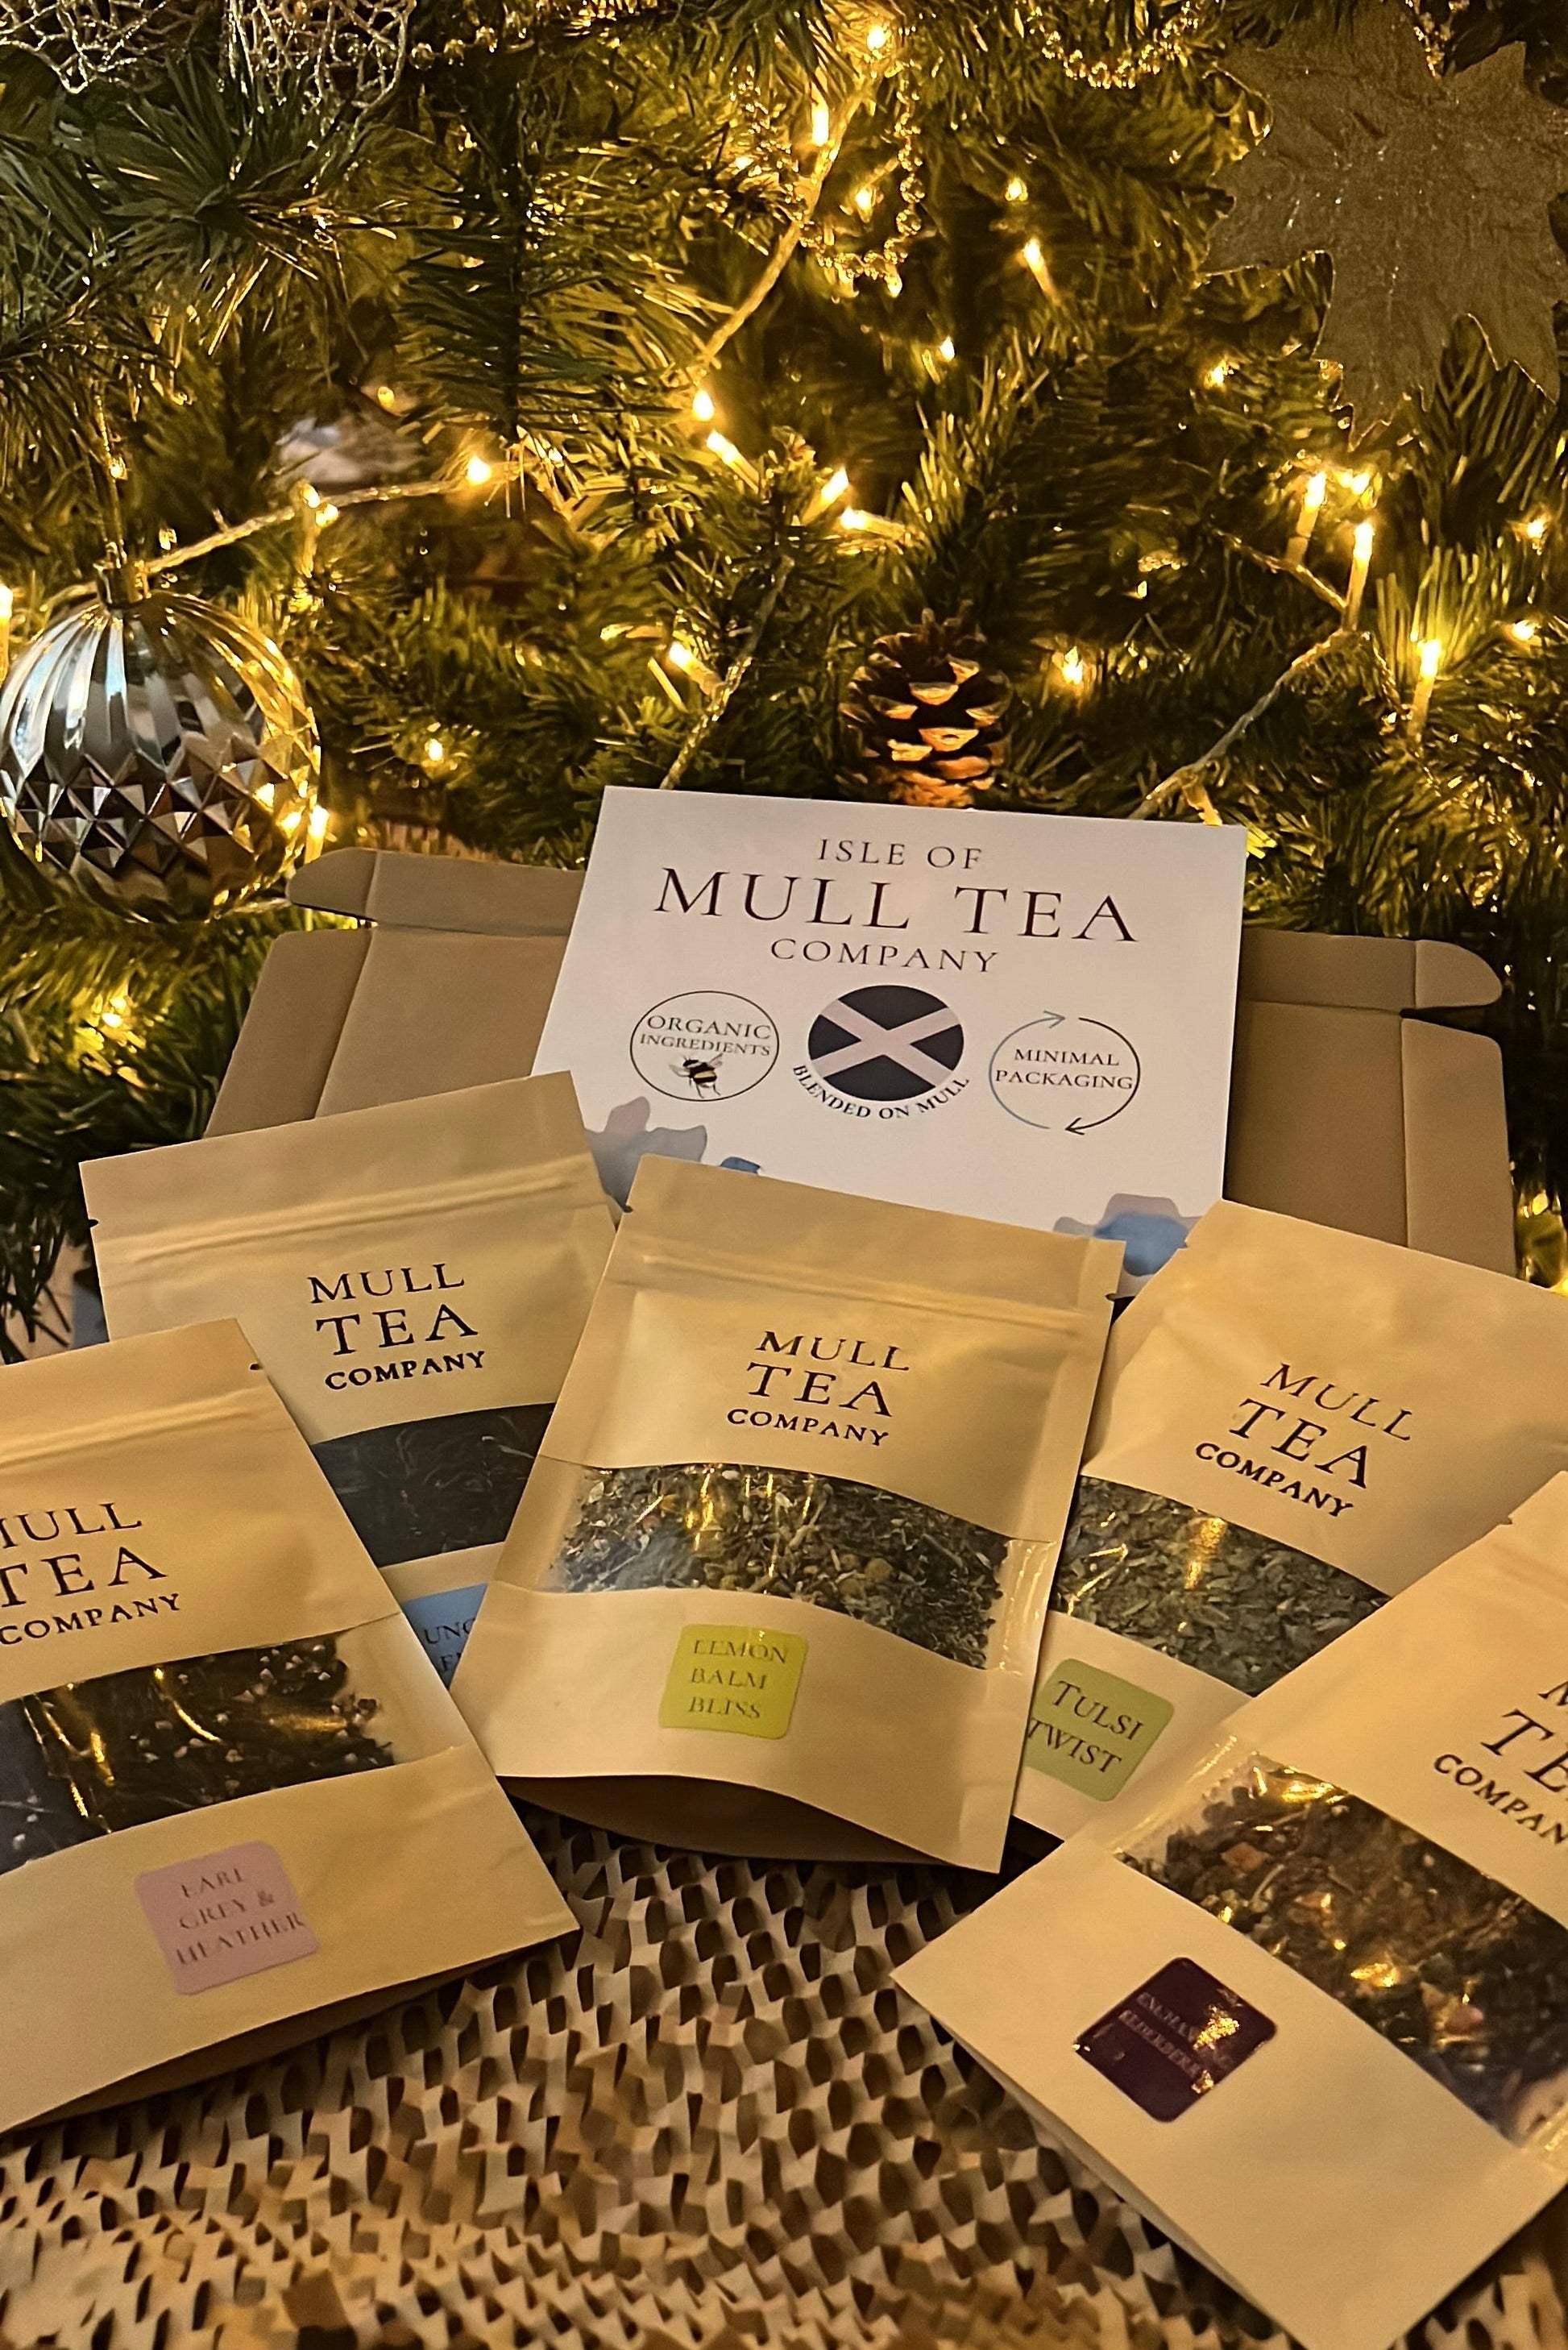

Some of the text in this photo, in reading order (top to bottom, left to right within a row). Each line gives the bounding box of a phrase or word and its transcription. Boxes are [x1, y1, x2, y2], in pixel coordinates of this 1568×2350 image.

[817, 838, 983, 870] ISLE OF
[653, 866, 1139, 943] MULL TEA
[770, 937, 999, 974] COMPANY
[640, 1033, 770, 1057] INGREDIENTS
[646, 1015, 772, 1040] ORGANIC
[1014, 1048, 1120, 1066] MINIMAL
[793, 1064, 970, 1119] BLENDED ON MULL
[995, 1069, 1133, 1090] PACKAGING
[307, 1263, 465, 1304] MULL
[315, 1303, 479, 1356] TEA
[325, 1350, 485, 1390] COMPANY
[754, 1331, 910, 1371] MULL
[746, 1361, 893, 1418] TEA
[1259, 1362, 1412, 1441] MULL
[727, 1408, 890, 1447] COMPANY
[1229, 1397, 1367, 1489] TEA
[1195, 1442, 1354, 1517] COMPANY
[0, 1546, 168, 1608] TEA
[0, 1592, 180, 1645] COMPANY
[694, 1639, 788, 1664] LEMON
[691, 1667, 768, 1689] BALM
[688, 1696, 761, 1719] BLISS
[1052, 1680, 1144, 1741] TULSI
[1027, 1717, 1122, 1773] TWIST
[256, 1890, 275, 1908] &
